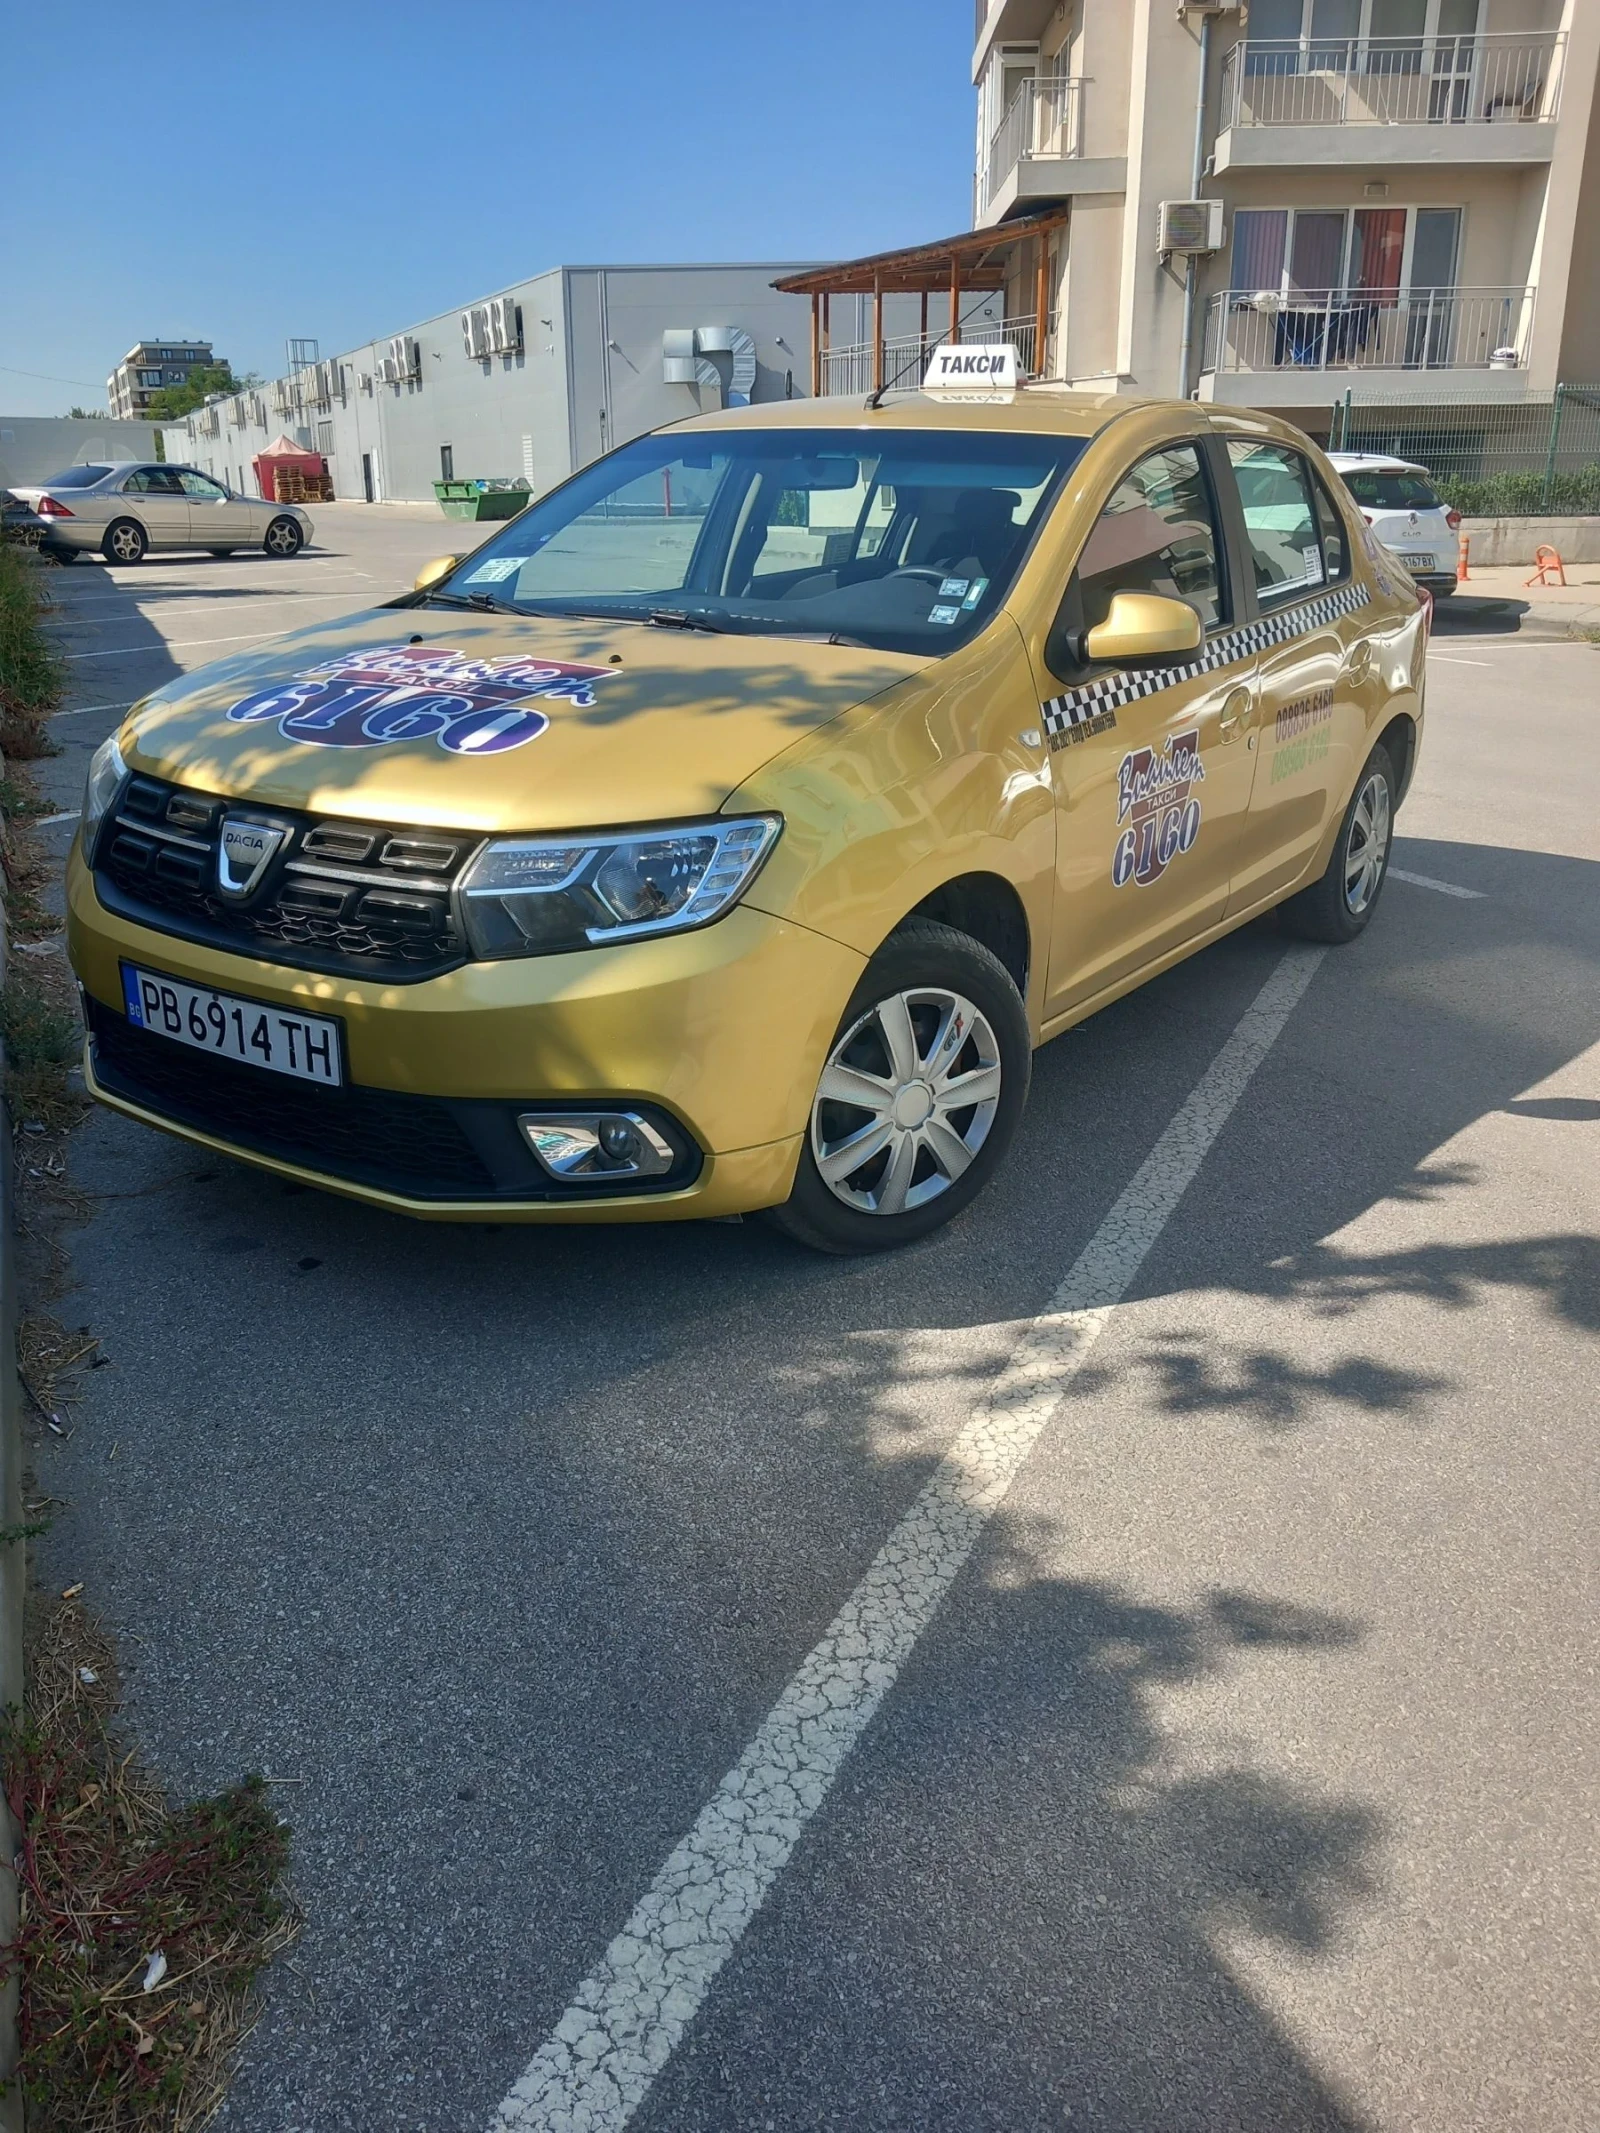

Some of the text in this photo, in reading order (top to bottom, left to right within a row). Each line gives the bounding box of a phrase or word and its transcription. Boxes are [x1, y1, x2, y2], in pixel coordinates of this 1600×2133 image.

[940, 355, 1005, 373] ТАКСИ
[383, 673, 482, 693] ТАКСИ
[226, 681, 550, 756] 6160
[1146, 787, 1177, 811] ТАКСИ
[226, 832, 263, 850] DACIA
[1112, 798, 1201, 887] 6160
[129, 1001, 142, 1019] BG
[141, 979, 332, 1078] PB 6914 TH
